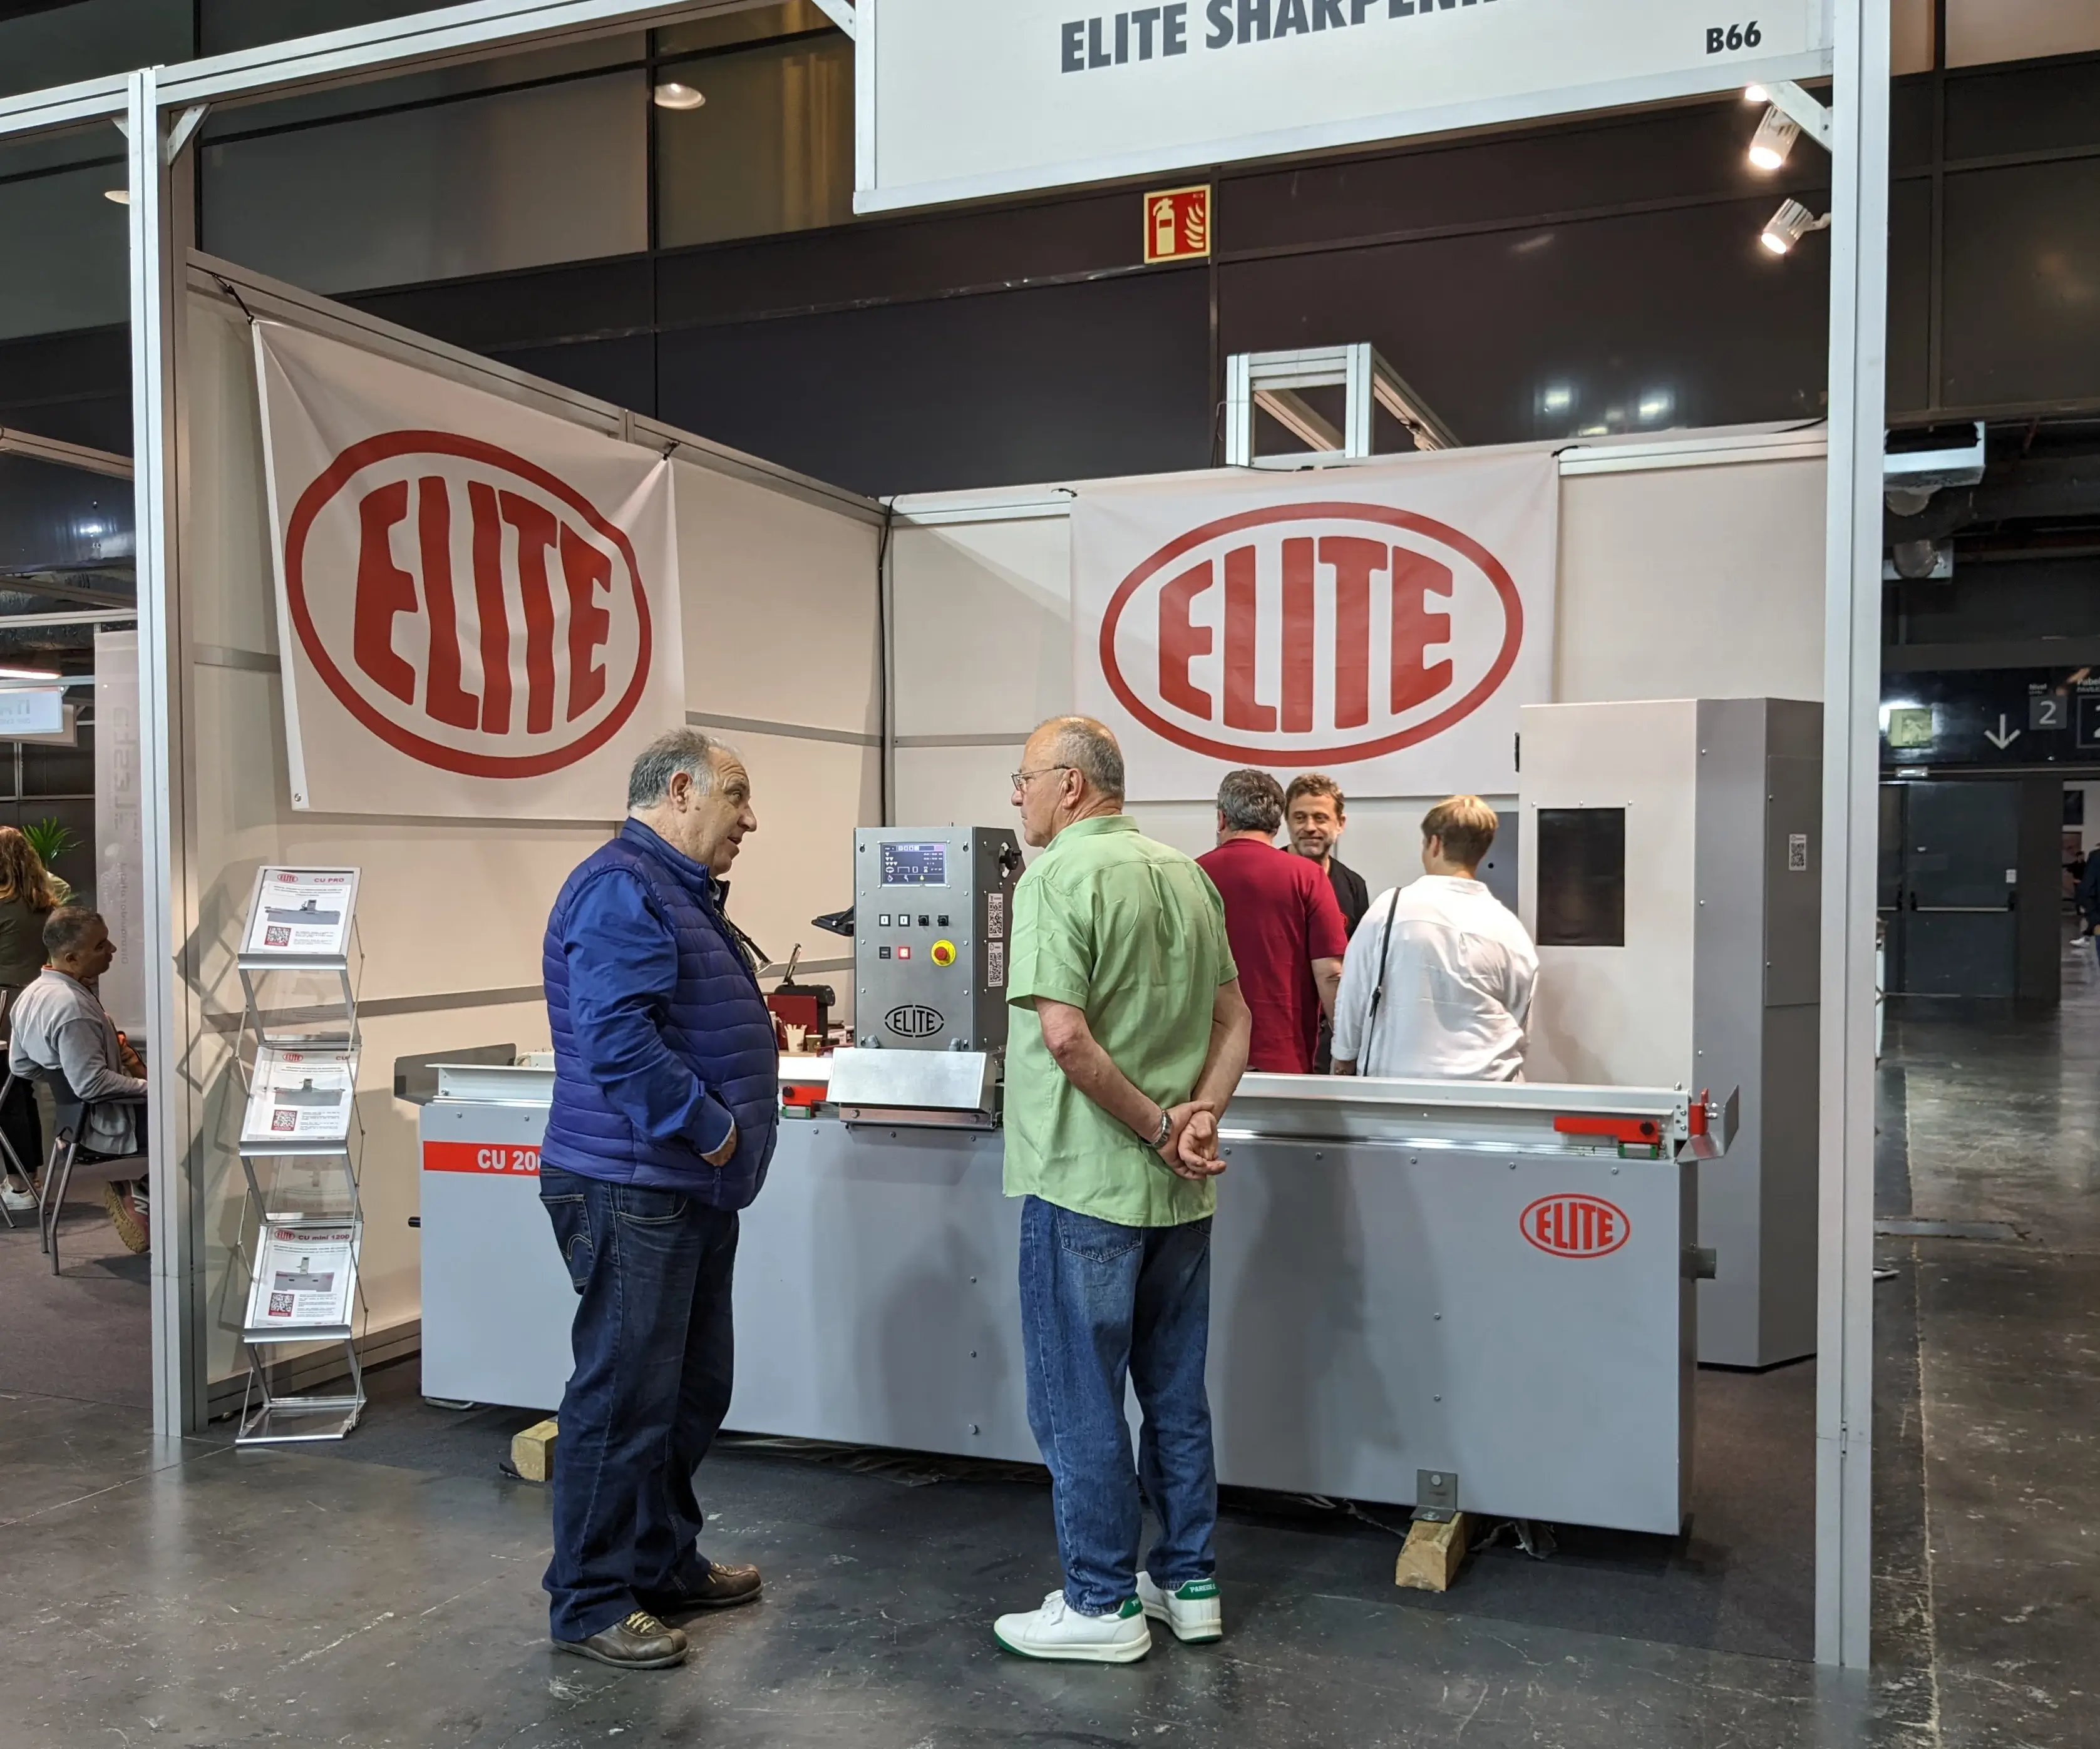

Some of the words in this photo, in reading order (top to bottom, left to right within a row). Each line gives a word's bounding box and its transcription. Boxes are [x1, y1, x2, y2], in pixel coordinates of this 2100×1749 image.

[1061, 2, 1187, 74] ELITE
[1706, 20, 1761, 54] B66
[354, 475, 612, 735] ELITE
[1158, 536, 1453, 733] ELITE
[2039, 700, 2057, 725] 2
[893, 1009, 935, 1033] ELITE
[478, 1149, 506, 1169] CU
[1536, 1201, 1614, 1250] ELITE
